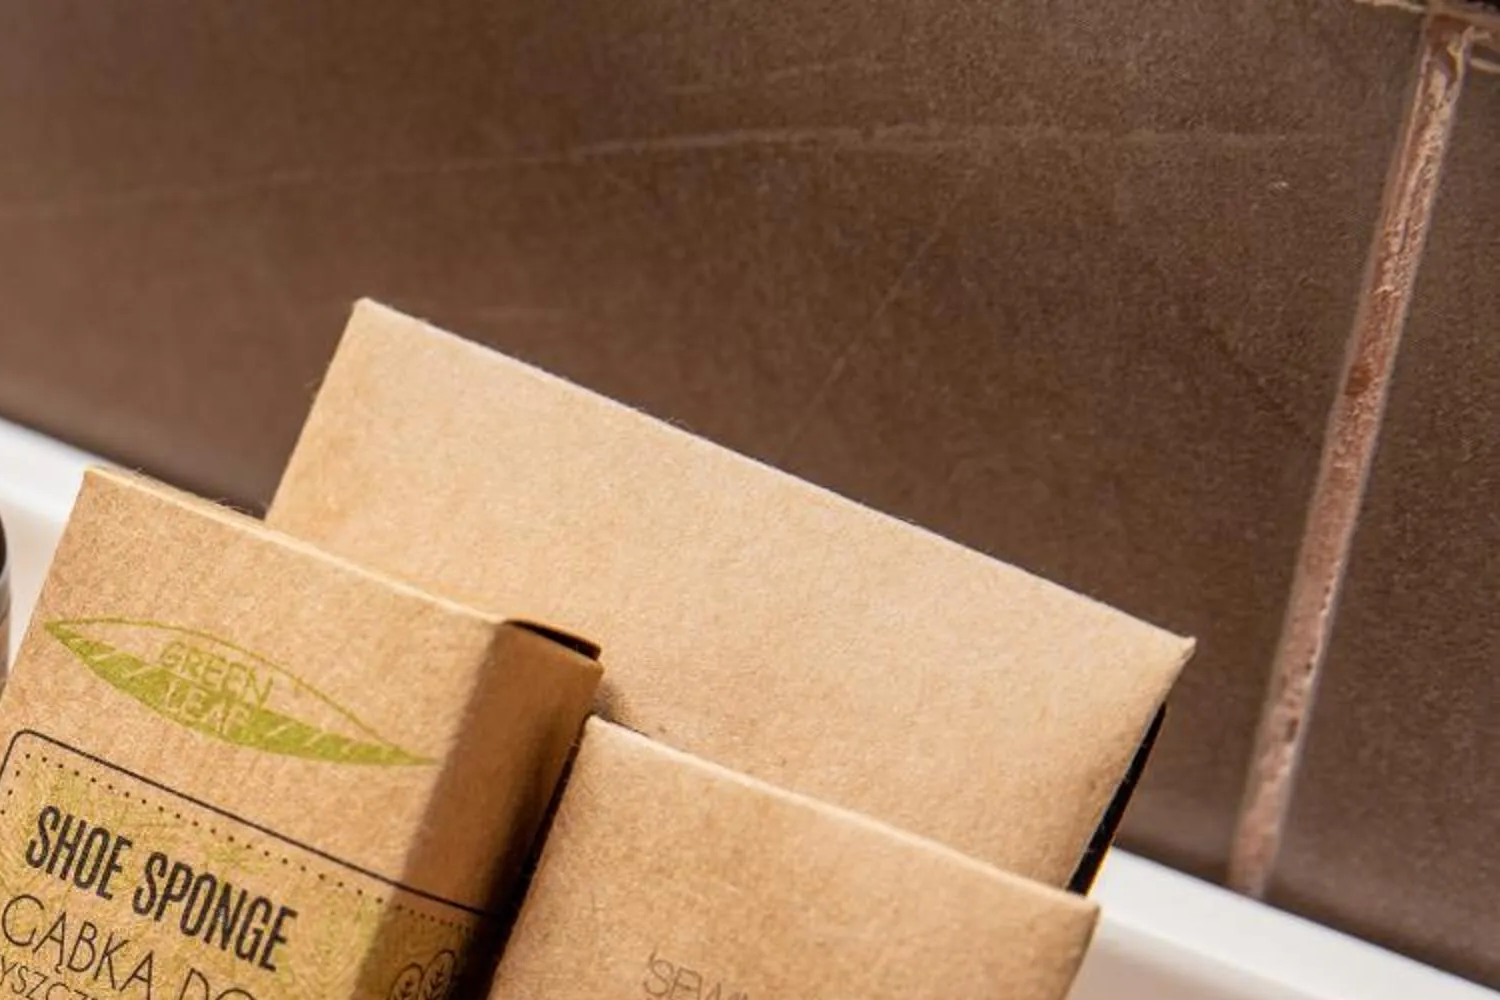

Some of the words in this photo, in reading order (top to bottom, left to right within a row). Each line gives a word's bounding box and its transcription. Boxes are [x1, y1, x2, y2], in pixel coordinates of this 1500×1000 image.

[159, 640, 274, 706] GREEN
[25, 805, 132, 900] SHOE
[131, 851, 298, 972] SPONGE
